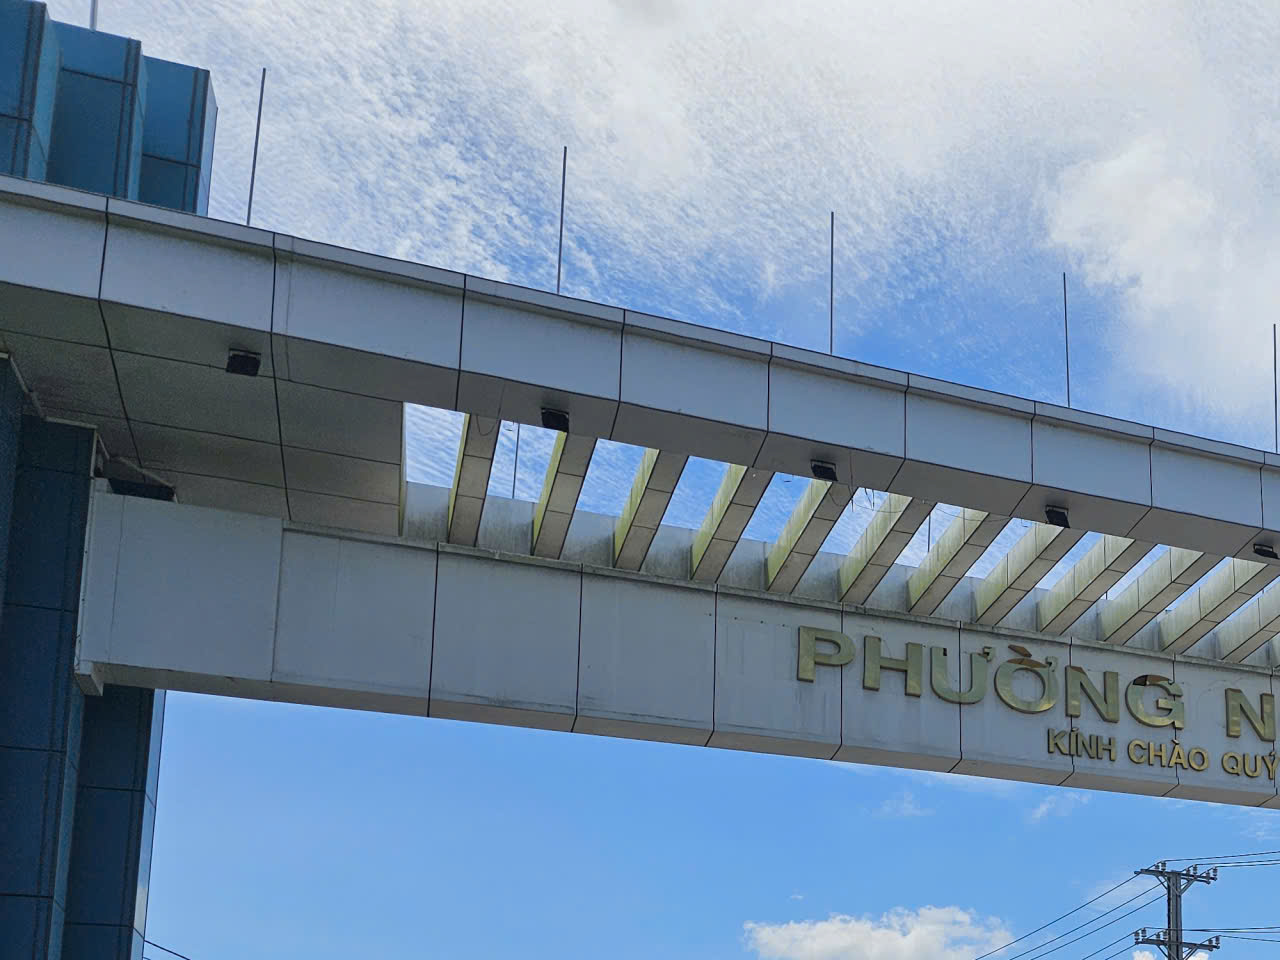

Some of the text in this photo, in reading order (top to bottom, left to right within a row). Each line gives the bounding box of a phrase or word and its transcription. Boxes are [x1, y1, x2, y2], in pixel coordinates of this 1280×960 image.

[797, 625, 1186, 731] PHƯỜNG
[1047, 725, 1117, 763] KÍNH
[1127, 738, 1210, 774] CHÀO
[1222, 749, 1280, 782] QUÝ
